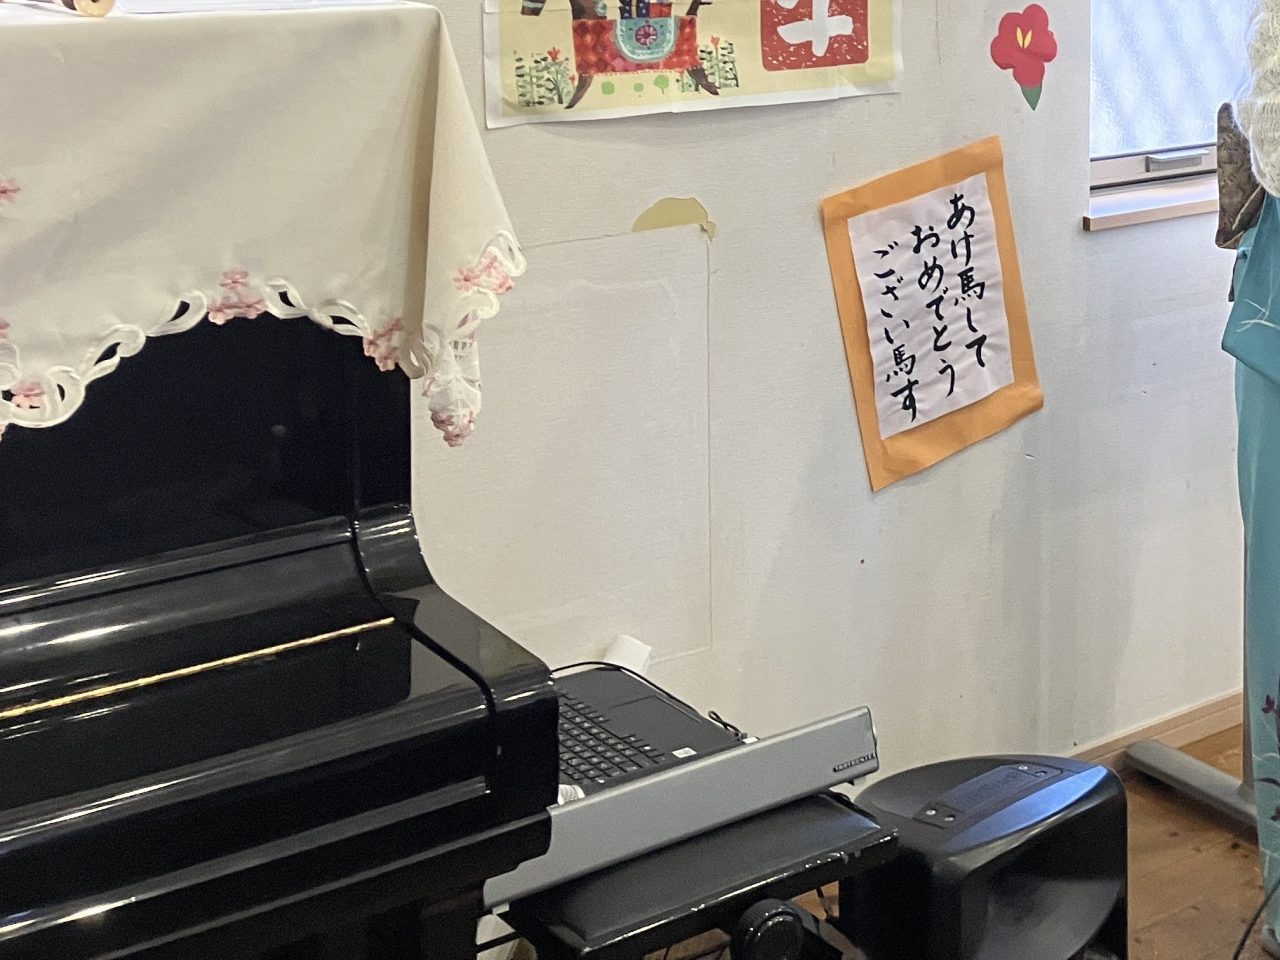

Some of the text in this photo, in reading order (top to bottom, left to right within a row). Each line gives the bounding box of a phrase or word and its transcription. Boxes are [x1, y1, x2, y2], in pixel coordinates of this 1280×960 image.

[873, 241, 920, 423] ござい馬す
[911, 225, 956, 398] おめでとう
[947, 193, 988, 368] あけ馬して
